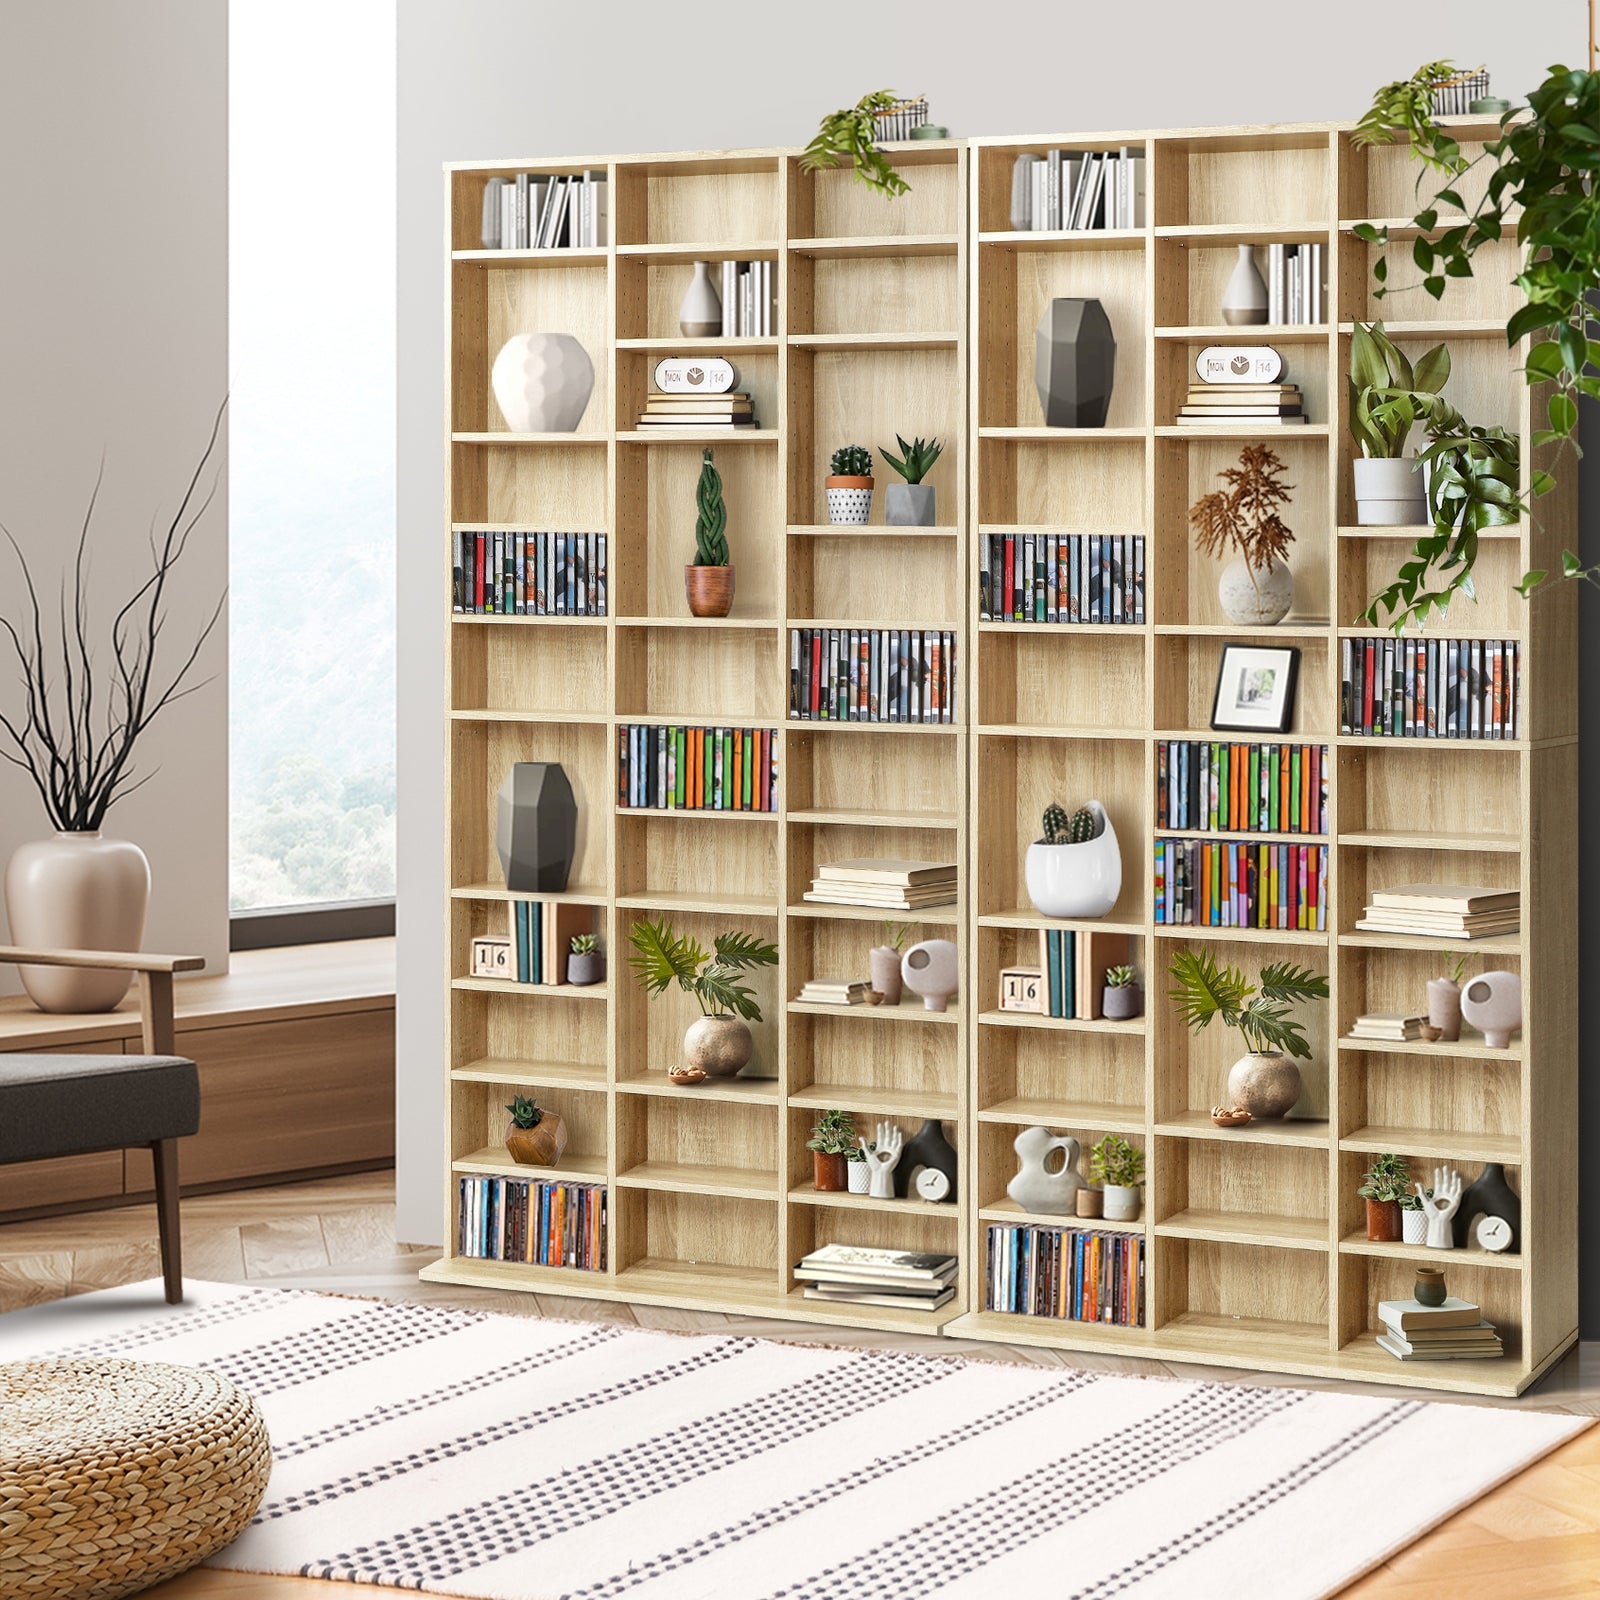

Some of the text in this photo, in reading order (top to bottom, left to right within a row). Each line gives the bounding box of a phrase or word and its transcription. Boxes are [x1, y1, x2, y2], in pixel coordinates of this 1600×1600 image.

[1209, 362, 1225, 372] MON
[1260, 363, 1271, 373] 14
[667, 372, 681, 382] MON
[714, 373, 724, 383] 14
